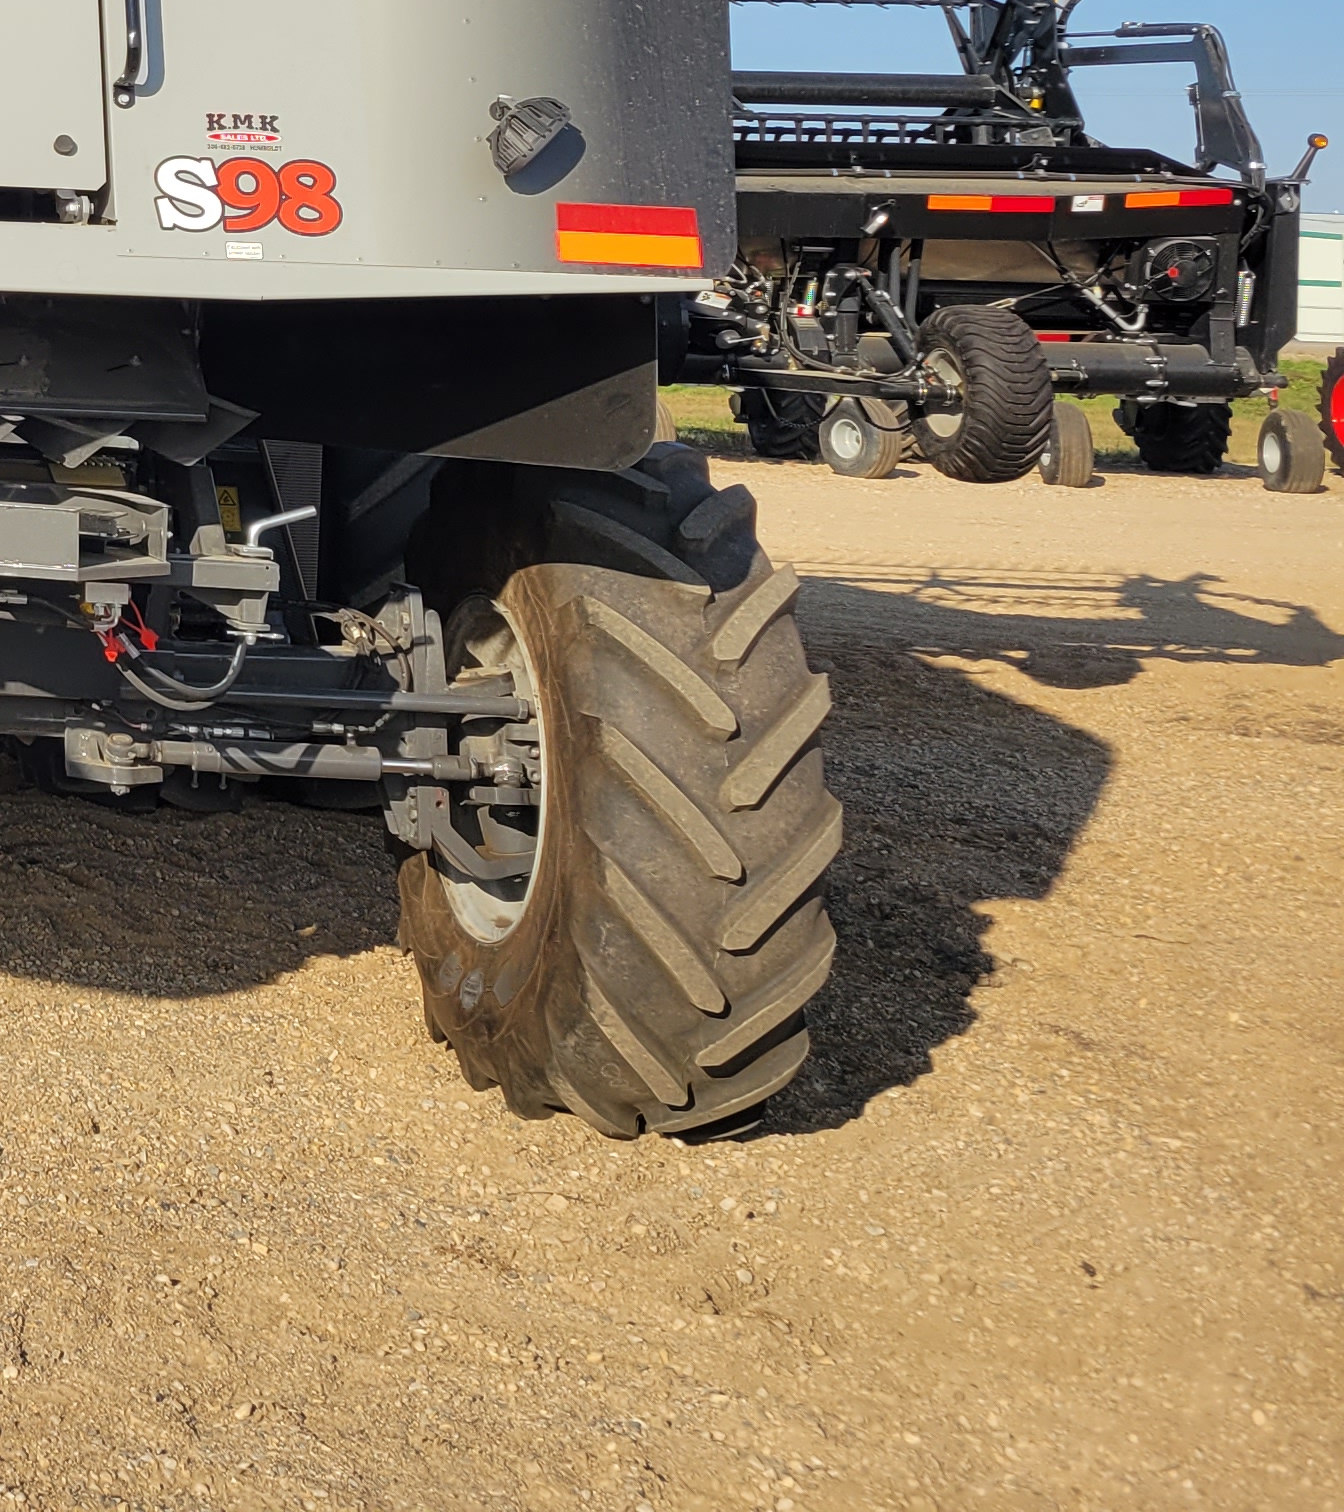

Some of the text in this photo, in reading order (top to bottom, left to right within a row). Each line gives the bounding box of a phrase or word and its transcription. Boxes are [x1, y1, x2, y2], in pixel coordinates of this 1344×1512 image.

[206, 113, 280, 133] K.M.K
[220, 133, 249, 141] SALES
[154, 155, 343, 237] S98
